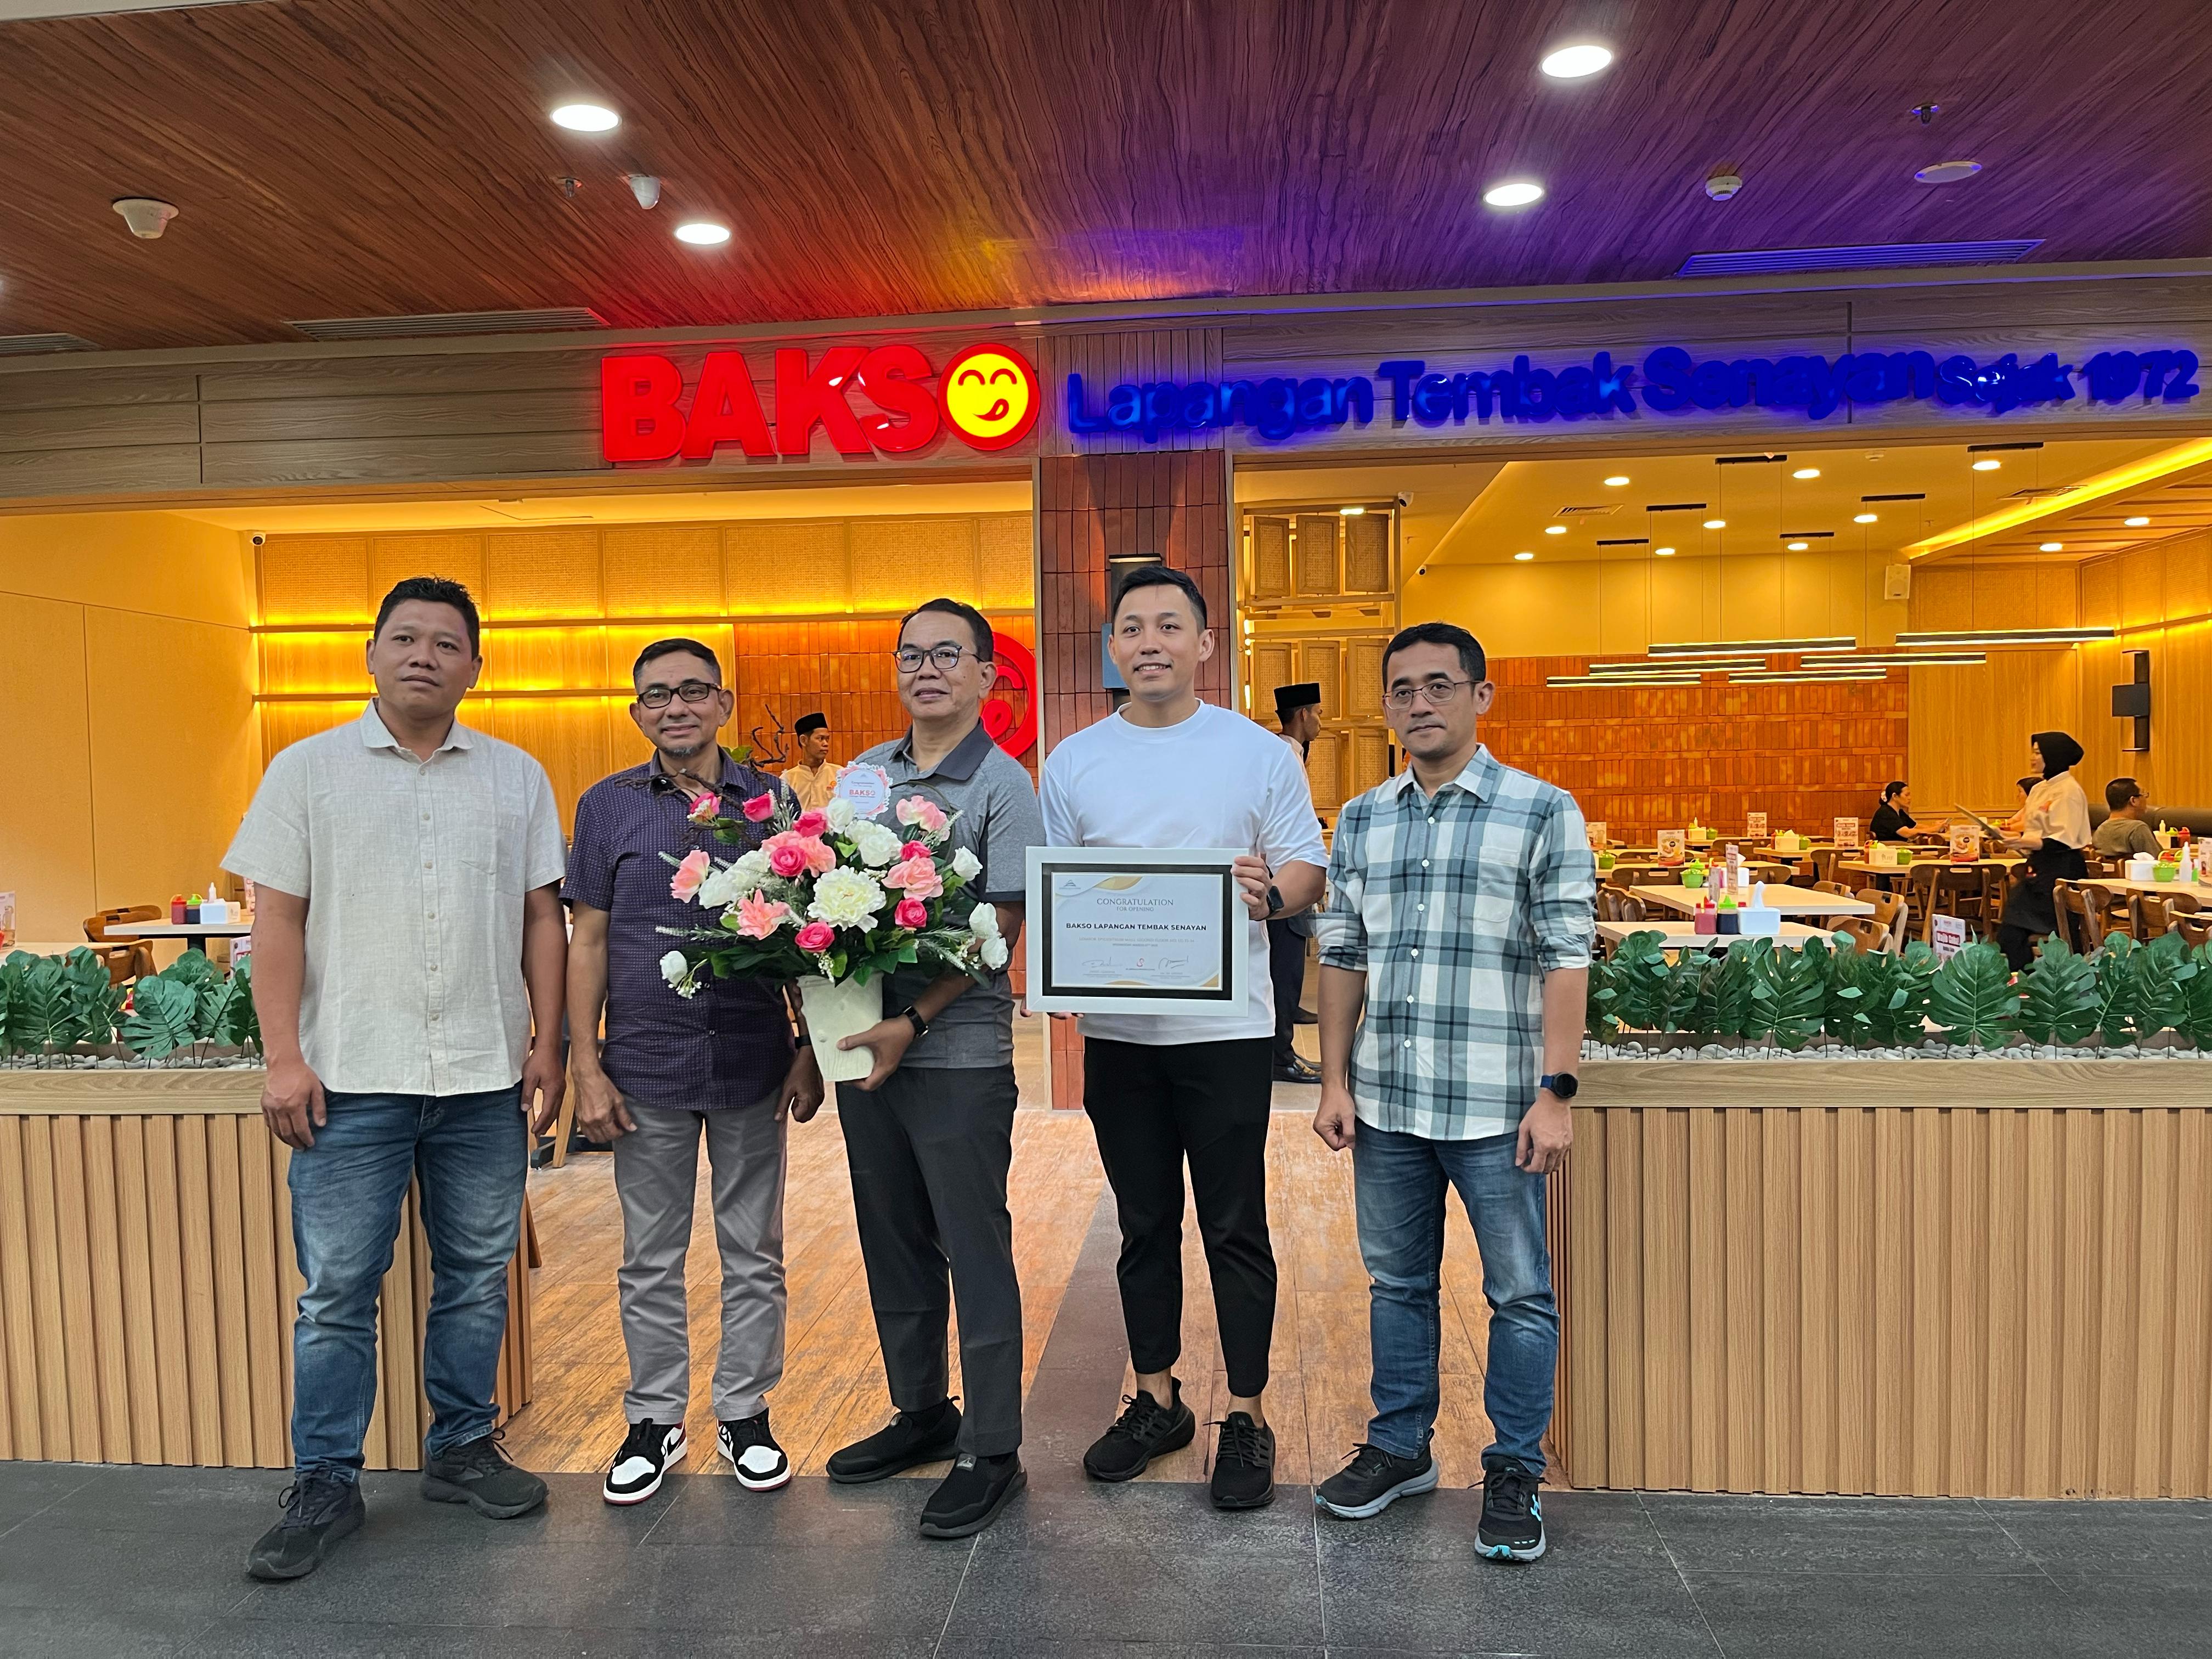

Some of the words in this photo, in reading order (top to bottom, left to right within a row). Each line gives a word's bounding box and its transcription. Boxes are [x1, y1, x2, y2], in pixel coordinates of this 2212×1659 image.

[1067, 373, 1374, 444] Lapangan
[1378, 351, 1637, 421] Tembak
[1642, 346, 1936, 420] Senayan
[2084, 349, 2199, 400] 1972
[1097, 898, 1173, 906] CONGRATULATION
